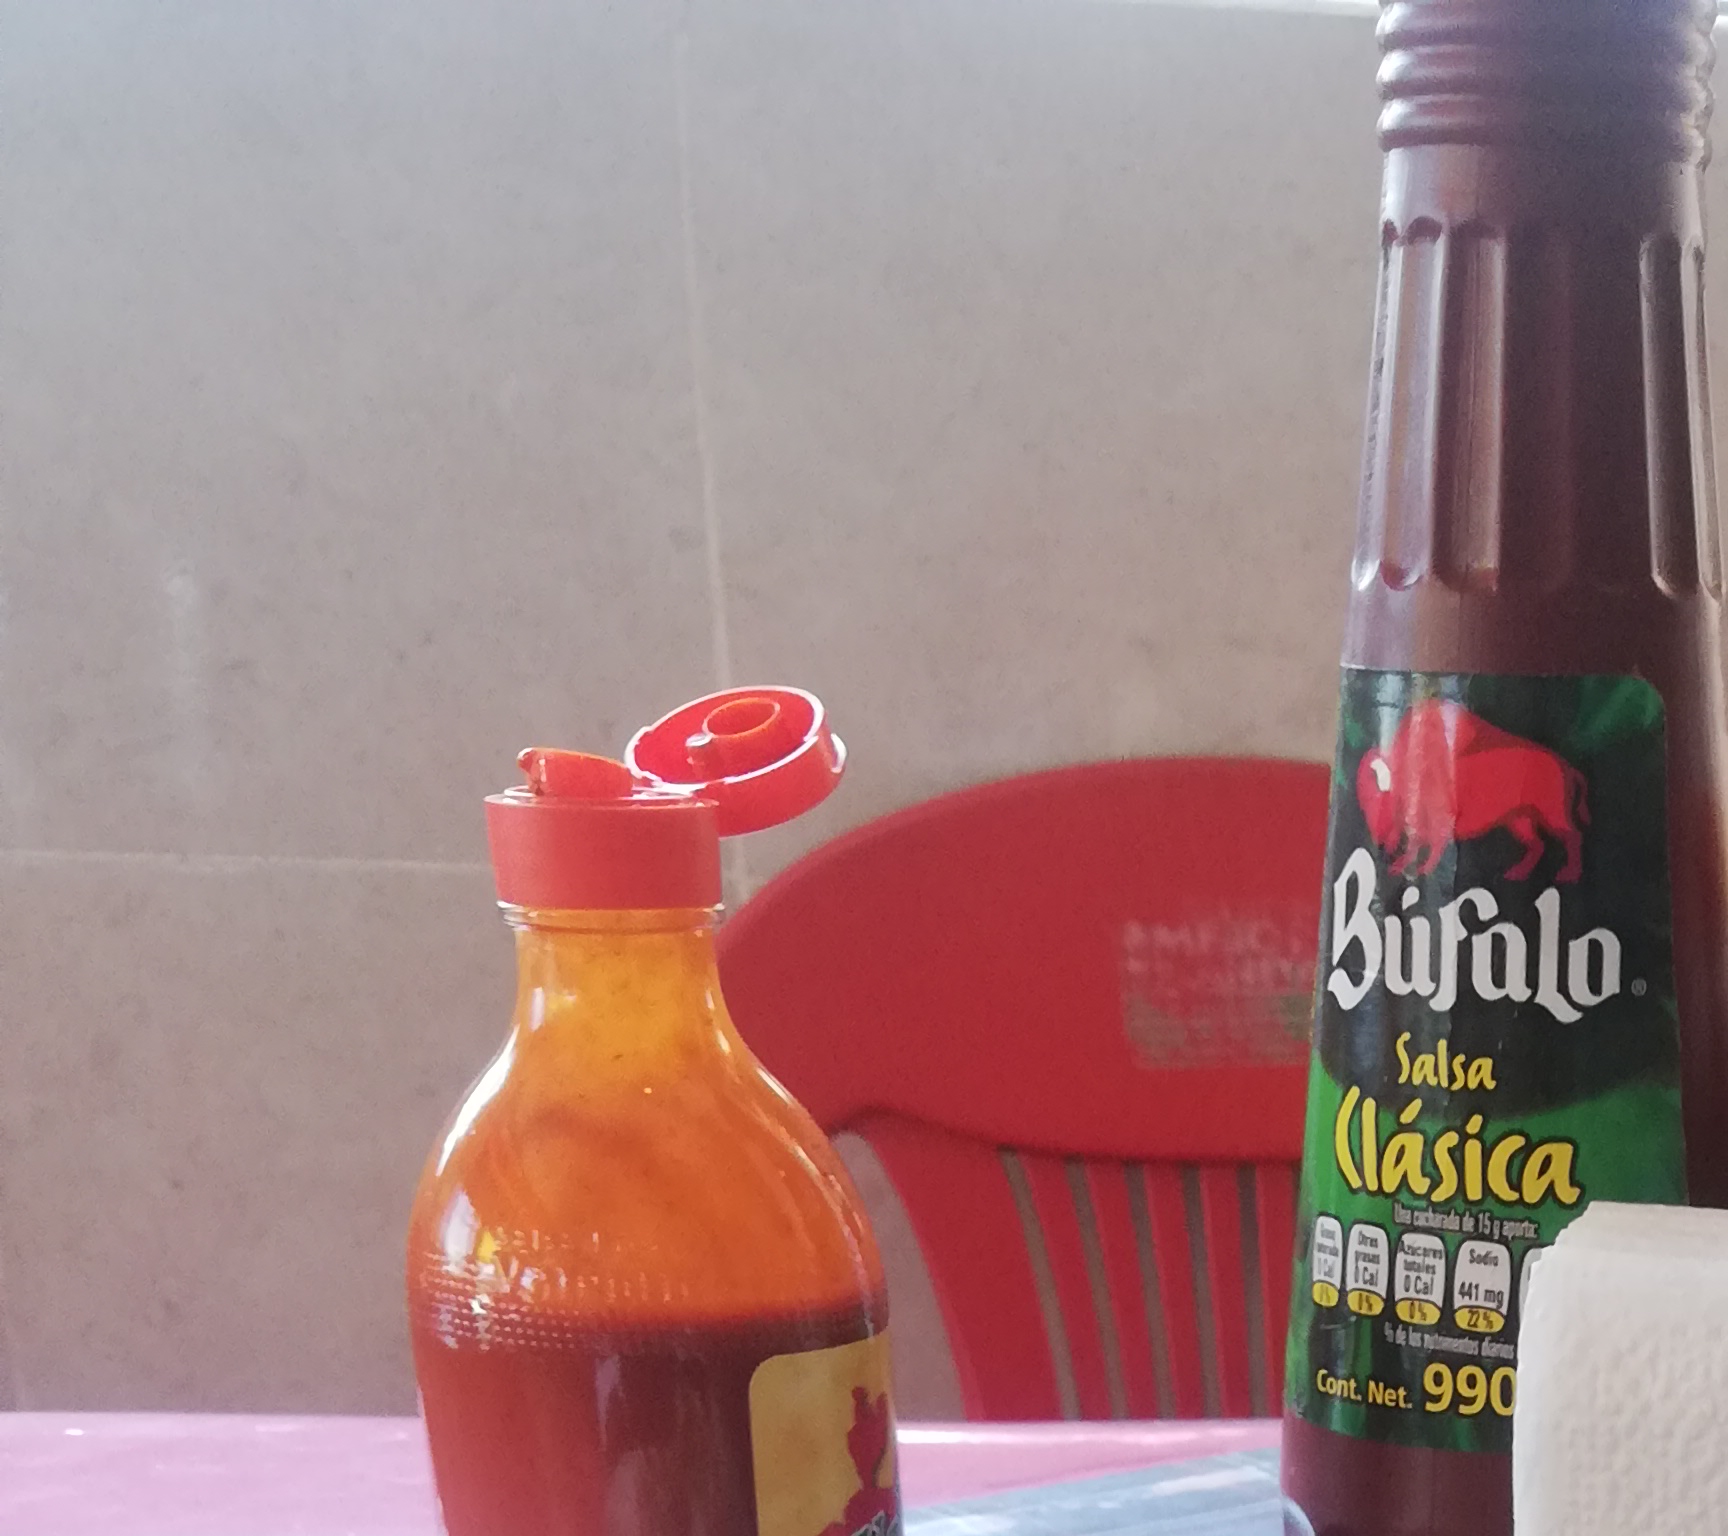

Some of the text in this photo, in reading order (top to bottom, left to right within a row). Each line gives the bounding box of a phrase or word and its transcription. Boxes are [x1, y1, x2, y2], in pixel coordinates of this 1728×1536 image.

[1327, 848, 1622, 1024] Búfalo
[1395, 1031, 1497, 1091] Salsa
[1334, 1085, 1582, 1205] Clásica
[1462, 1210, 1476, 1232] de
[1478, 1212, 1491, 1235] 15
[1468, 1247, 1499, 1268] Sodio
[1362, 1266, 1379, 1288] Cal
[1414, 1275, 1434, 1296] Cal
[1458, 1280, 1505, 1310] 441 mg
[1316, 1362, 1518, 1417] Cont. Net. 990
